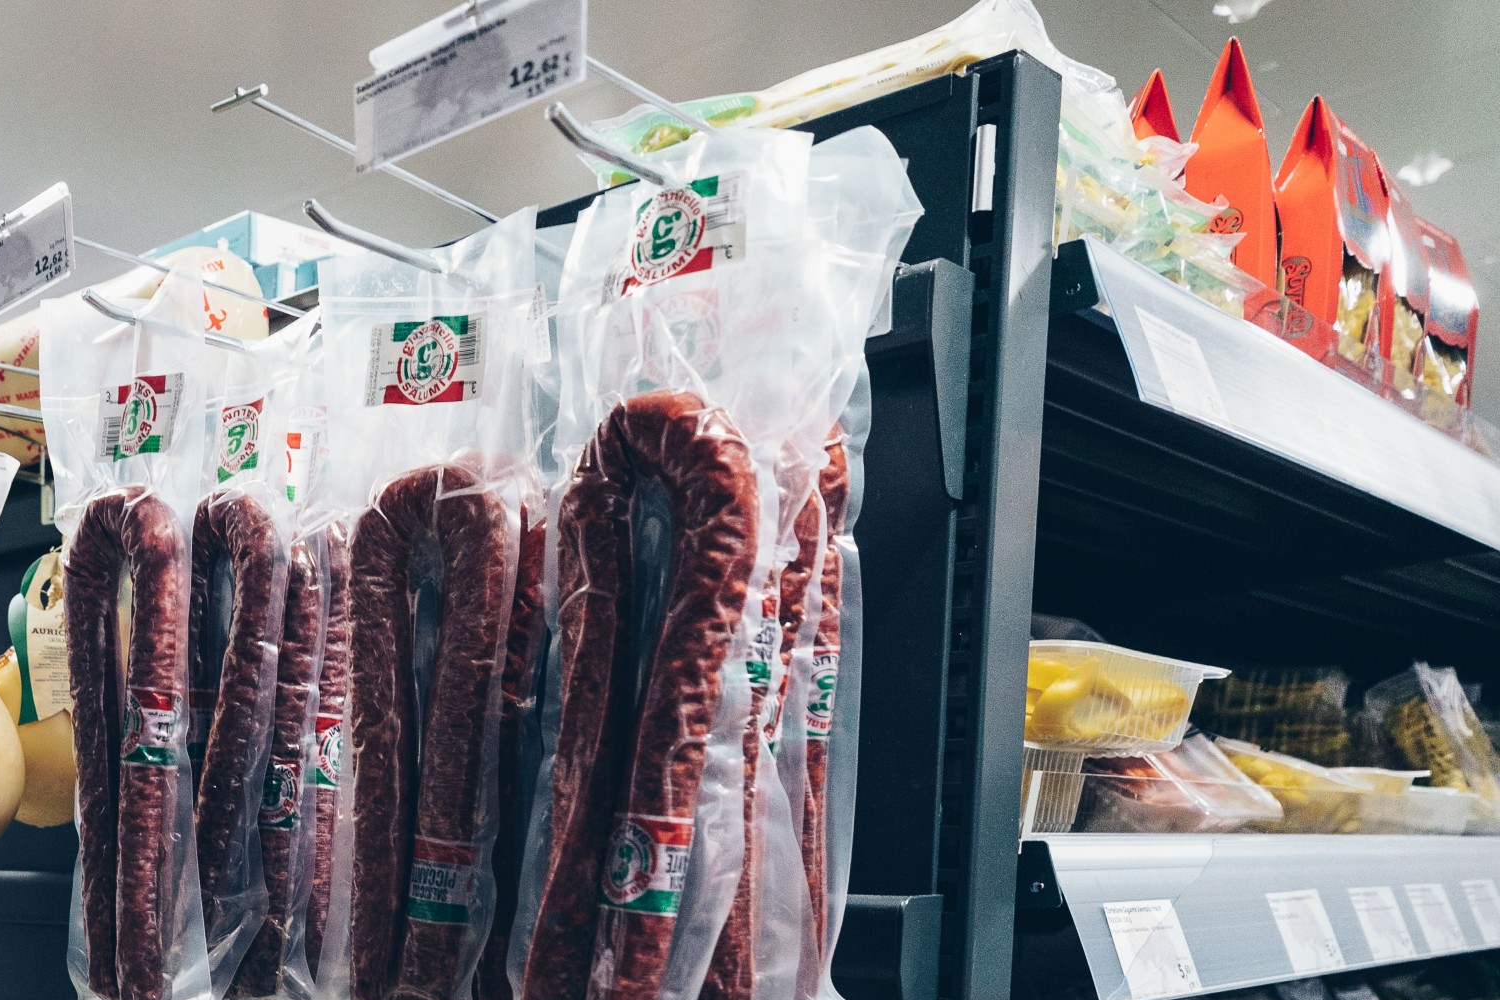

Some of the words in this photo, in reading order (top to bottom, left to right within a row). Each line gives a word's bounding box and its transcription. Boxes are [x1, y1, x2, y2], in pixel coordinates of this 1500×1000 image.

[510, 49, 558, 87] 12,62
[34, 247, 62, 276] 12,62
[638, 250, 691, 280] SALUMI
[402, 379, 445, 401] SALUMI
[222, 408, 257, 423] SALUM
[31, 628, 67, 637] AURIC
